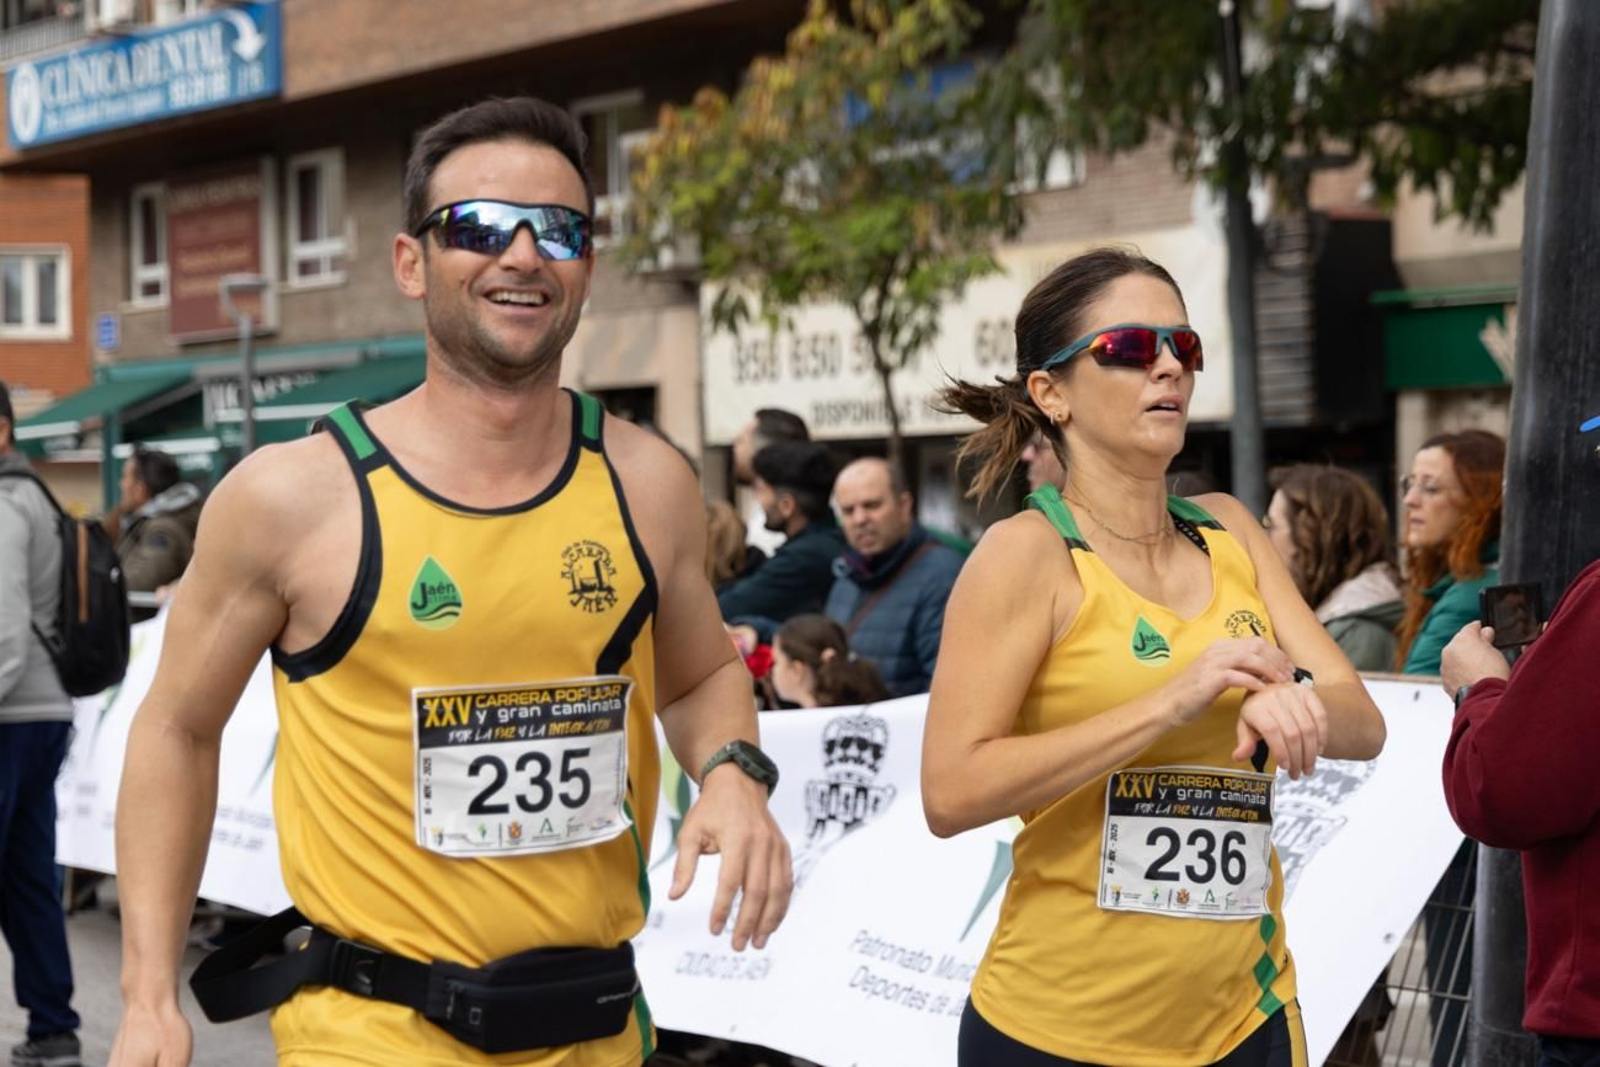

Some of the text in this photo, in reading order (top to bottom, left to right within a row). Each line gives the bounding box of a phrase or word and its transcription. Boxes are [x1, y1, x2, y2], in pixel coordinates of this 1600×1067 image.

[410, 581, 456, 611] Jaén
[424, 694, 473, 729] XXV
[475, 690, 552, 708] CARRERA
[497, 706, 541, 723] gran
[551, 698, 622, 716] caminata
[474, 728, 493, 741] LA
[528, 723, 546, 737] LA
[467, 747, 591, 816] 235
[1115, 773, 1267, 799] XXV CARRERA POPULAR
[1176, 788, 1212, 801] gran
[1220, 790, 1267, 805] caminata
[1155, 803, 1171, 814] LA
[1199, 805, 1215, 818] LA
[1144, 826, 1247, 886] 236
[849, 929, 933, 973] Patronato
[848, 965, 931, 1010] Deportes
